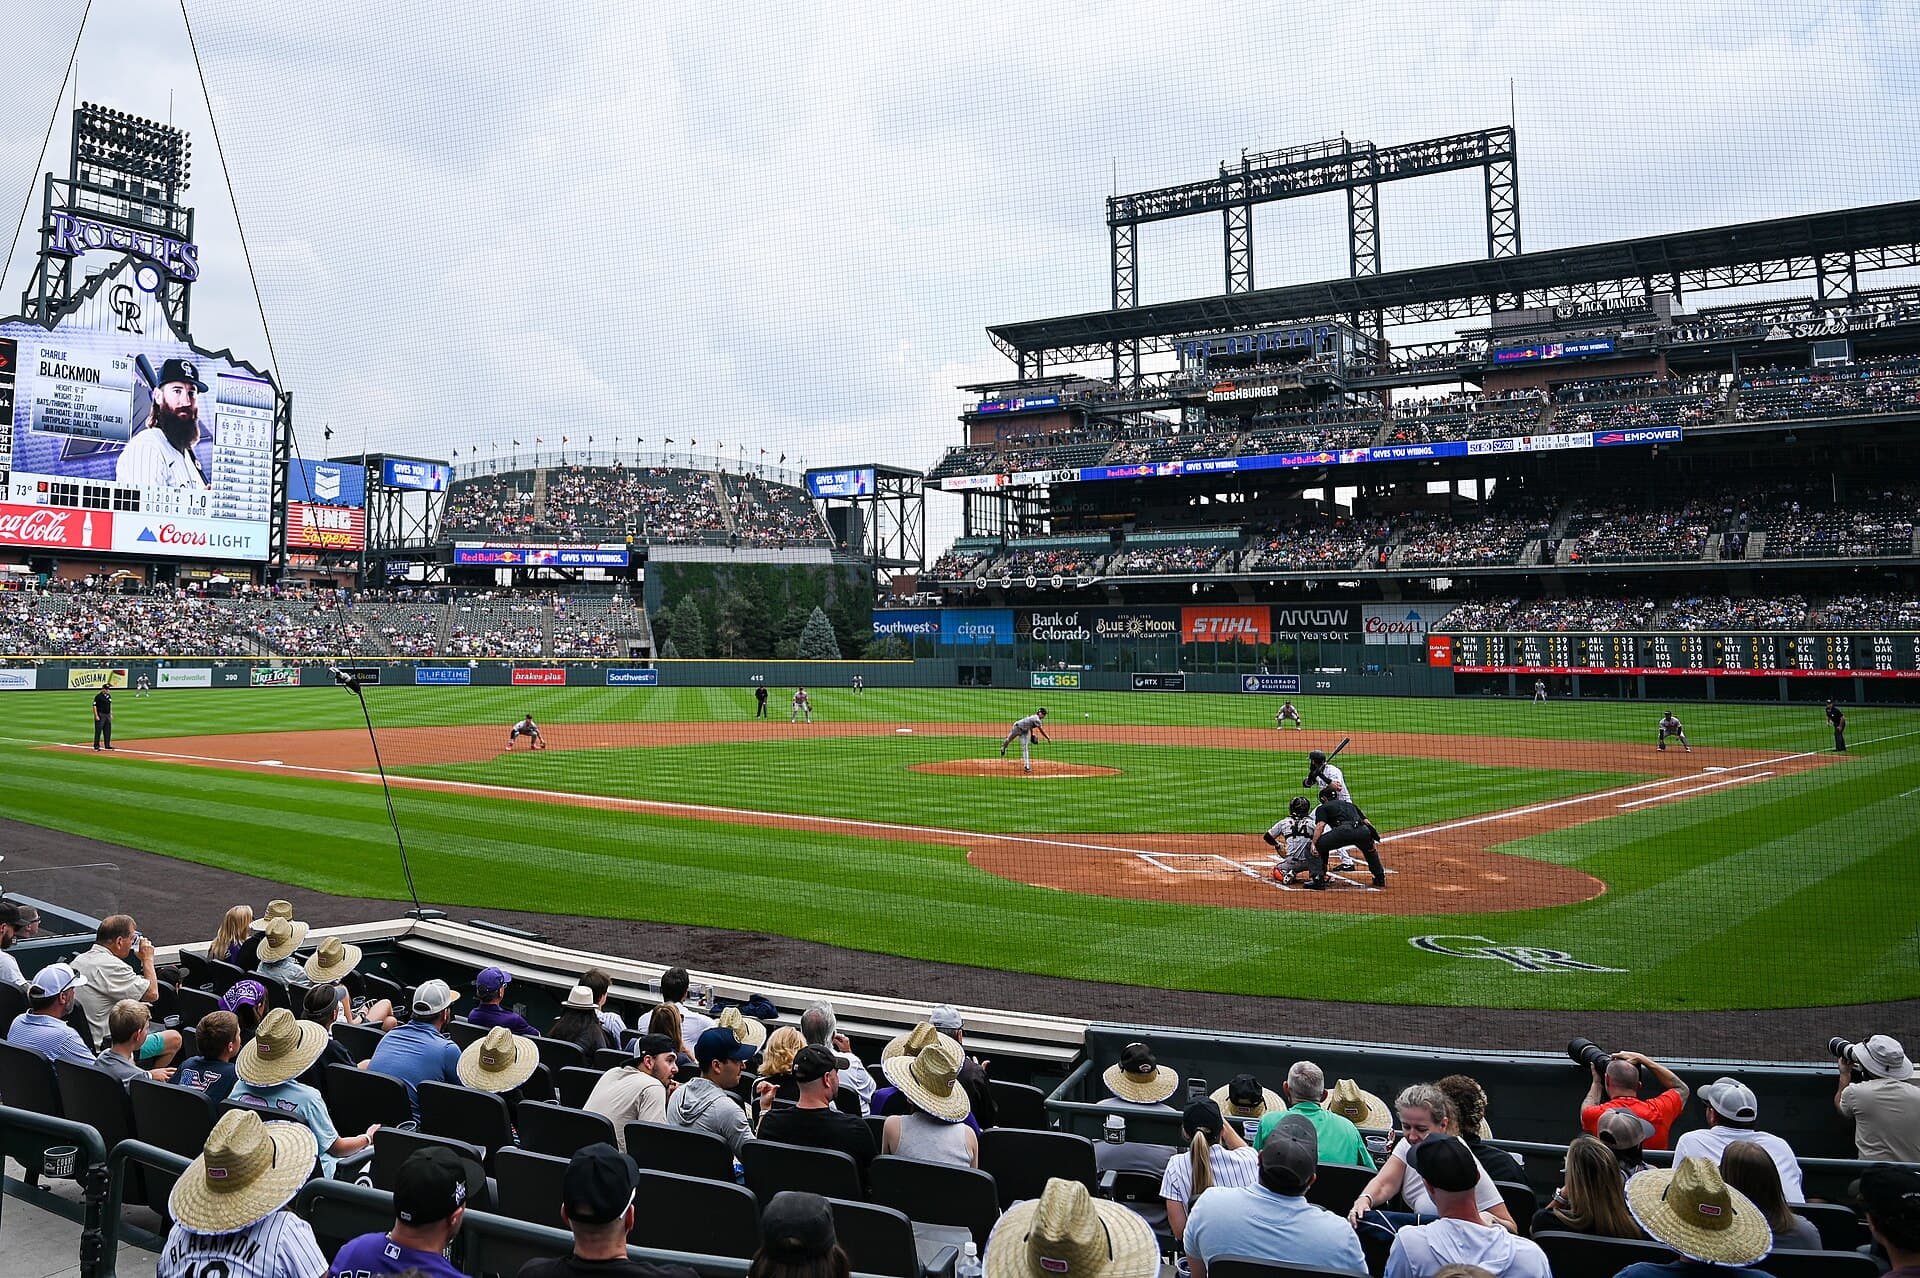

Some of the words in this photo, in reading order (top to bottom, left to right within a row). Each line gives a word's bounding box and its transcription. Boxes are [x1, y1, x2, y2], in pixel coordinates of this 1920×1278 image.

[50, 213, 199, 282] ROCKIES
[1578, 301, 1604, 313] JACK
[1795, 321, 1848, 337] Silver
[1175, 340, 1212, 360] THE
[1228, 327, 1328, 355] ROOFTOP
[40, 348, 68, 361] CHARLIE
[112, 360, 119, 370] 19
[120, 362, 128, 370] DH
[40, 361, 100, 384] BLACKMON
[1624, 430, 1679, 442] EMPOWER
[1373, 449, 1391, 458] GIVES
[1392, 448, 1405, 456] YOU
[394, 464, 411, 474] GIVES
[412, 466, 425, 475] YOU
[1186, 462, 1202, 470] GIVES
[1203, 462, 1214, 470] YOU
[302, 508, 352, 529] KING
[159, 523, 206, 546] Coors
[210, 534, 251, 548] LIGHT
[303, 527, 352, 546] Soopers
[461, 553, 478, 561] Red
[479, 553, 494, 561] Bull
[977, 579, 985, 587] 42
[1027, 578, 1035, 586] 17
[1032, 612, 1063, 626] Bank
[1065, 611, 1079, 626] of
[1193, 618, 1258, 632] STIHL
[1280, 610, 1348, 626] ARROW
[873, 621, 930, 633] Southwest
[958, 622, 995, 639] cigna
[1096, 618, 1124, 633] BLUE
[1145, 620, 1175, 631] MOON
[1365, 617, 1415, 634] Coors
[1032, 626, 1090, 640] Colorado
[71, 673, 106, 688] LOUISIANA
[256, 672, 273, 683] TREE
[273, 671, 288, 680] TOP
[544, 673, 561, 681] plus
[1033, 674, 1077, 686] bet365
[1407, 934, 1629, 973] CR
[56, 1156, 74, 1166] COORS
[56, 1164, 73, 1175] FIELD
[170, 1235, 260, 1266] BLACKMON
